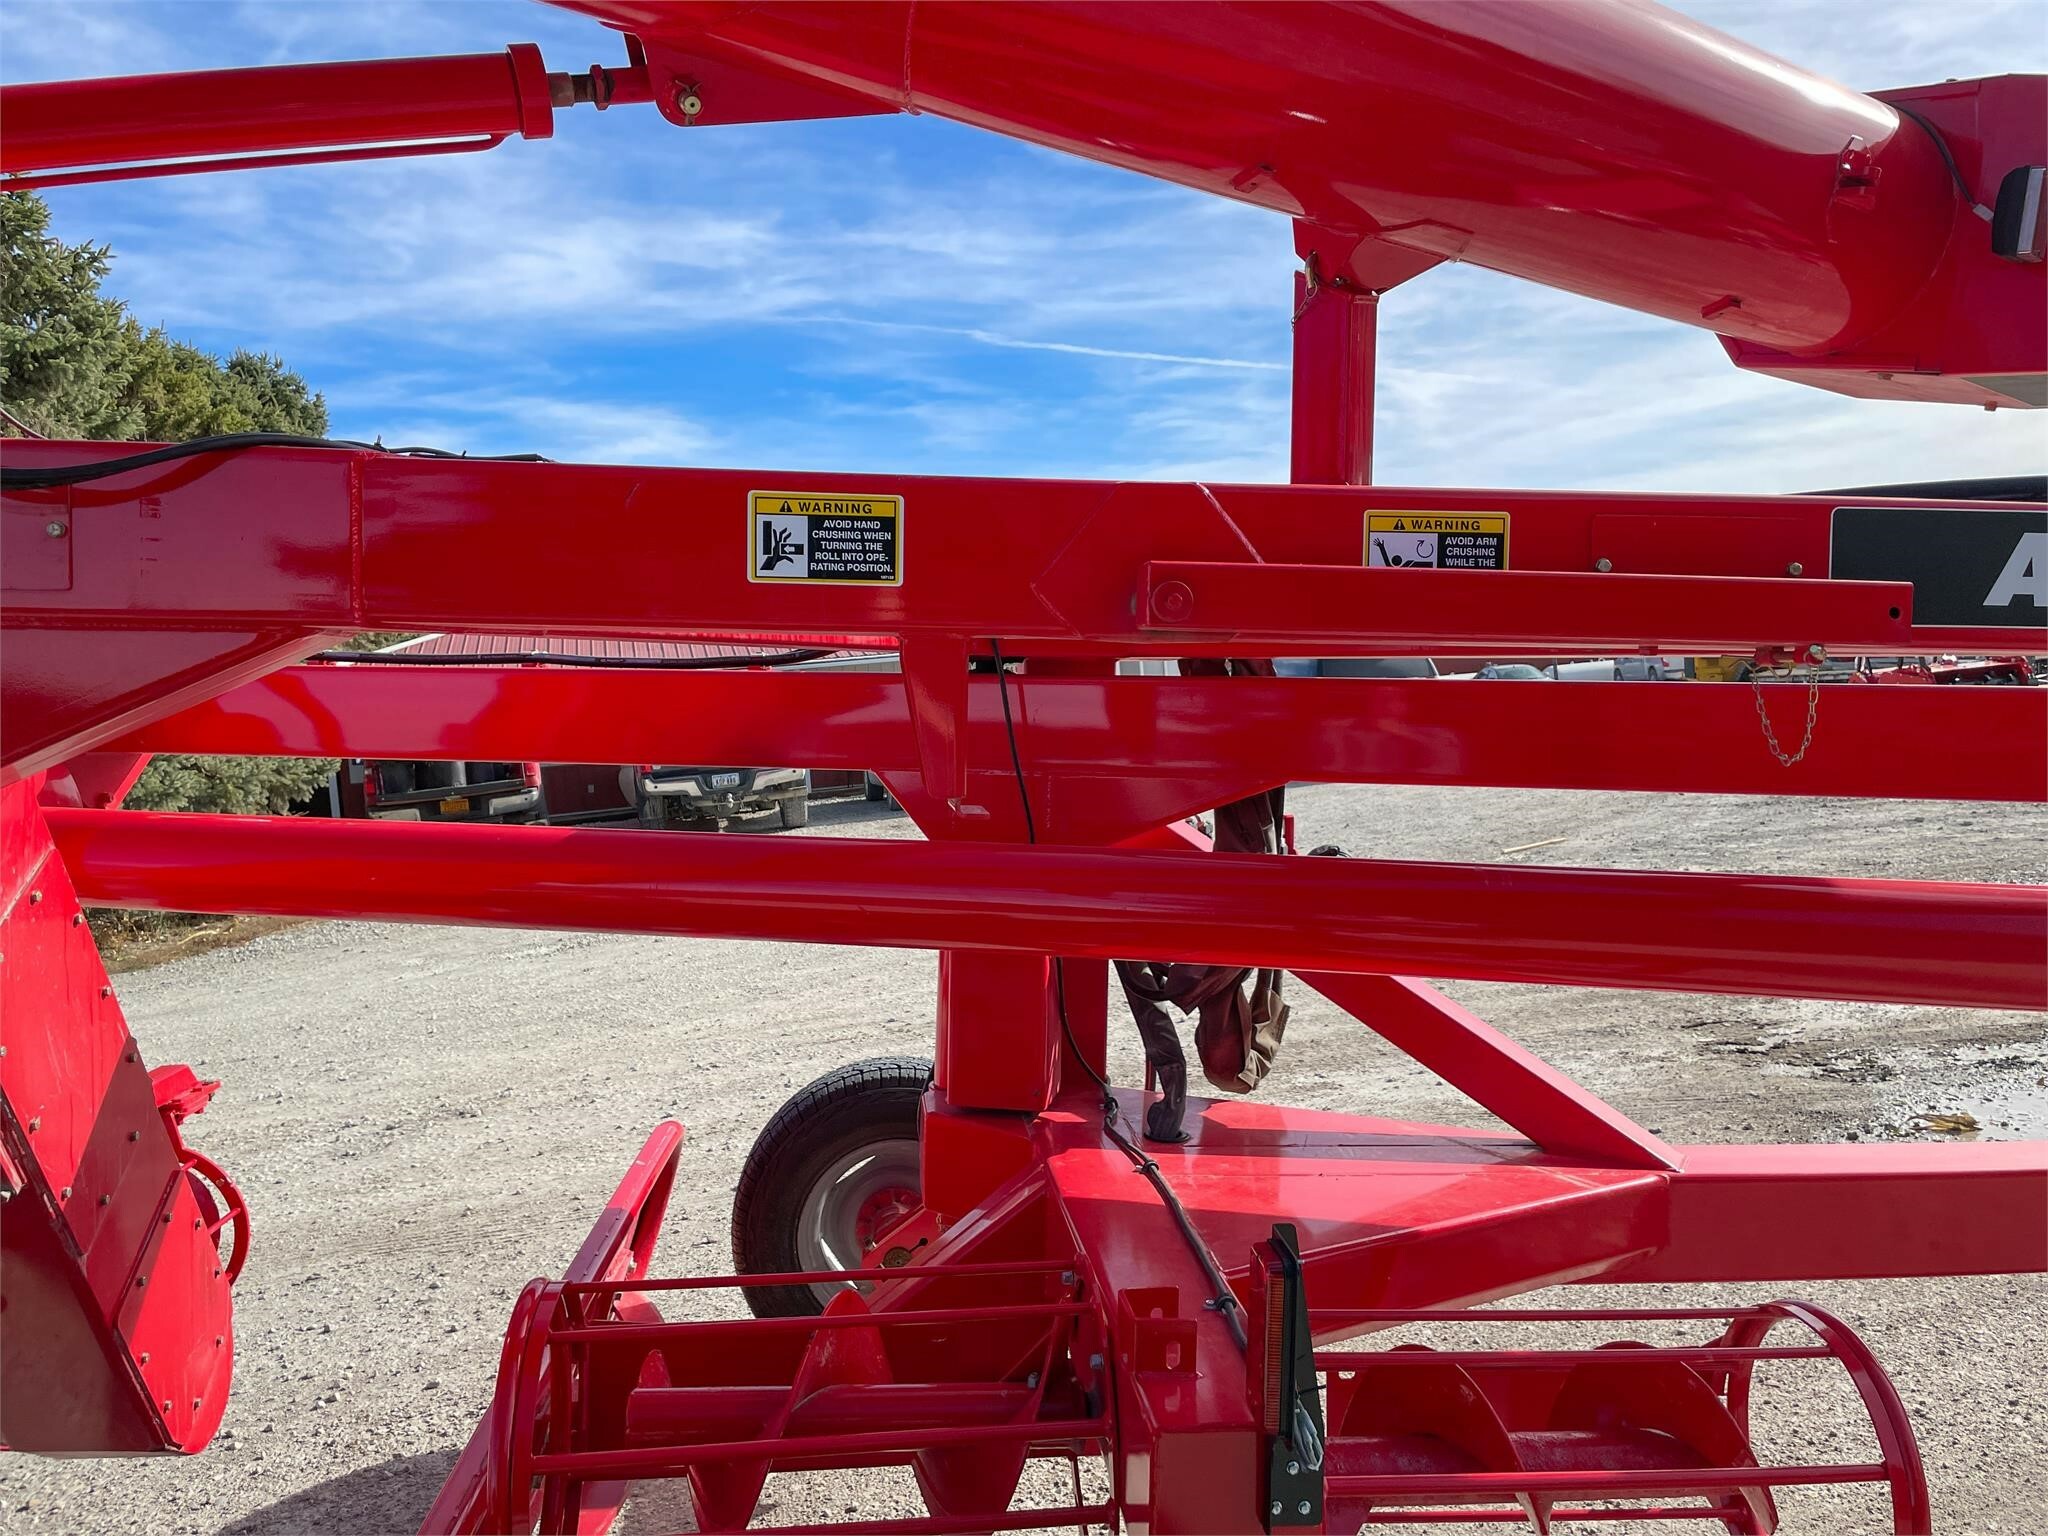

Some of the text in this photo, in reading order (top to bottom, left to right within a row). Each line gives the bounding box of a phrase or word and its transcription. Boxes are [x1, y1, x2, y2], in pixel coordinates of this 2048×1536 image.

[799, 502, 872, 514] WARNING
[823, 519, 881, 529] AVOID HAND
[1411, 520, 1481, 531] WARNING
[812, 530, 892, 540] CRUSHING WHEN
[820, 541, 883, 551] TURNING THE
[1445, 537, 1497, 546] AVOID ARM
[1446, 547, 1496, 556] CRUSHING
[815, 552, 889, 562] ROLL INTO OPE-
[810, 562, 893, 572] RATING POSITION.
[1445, 558, 1496, 567] WHILE THE
